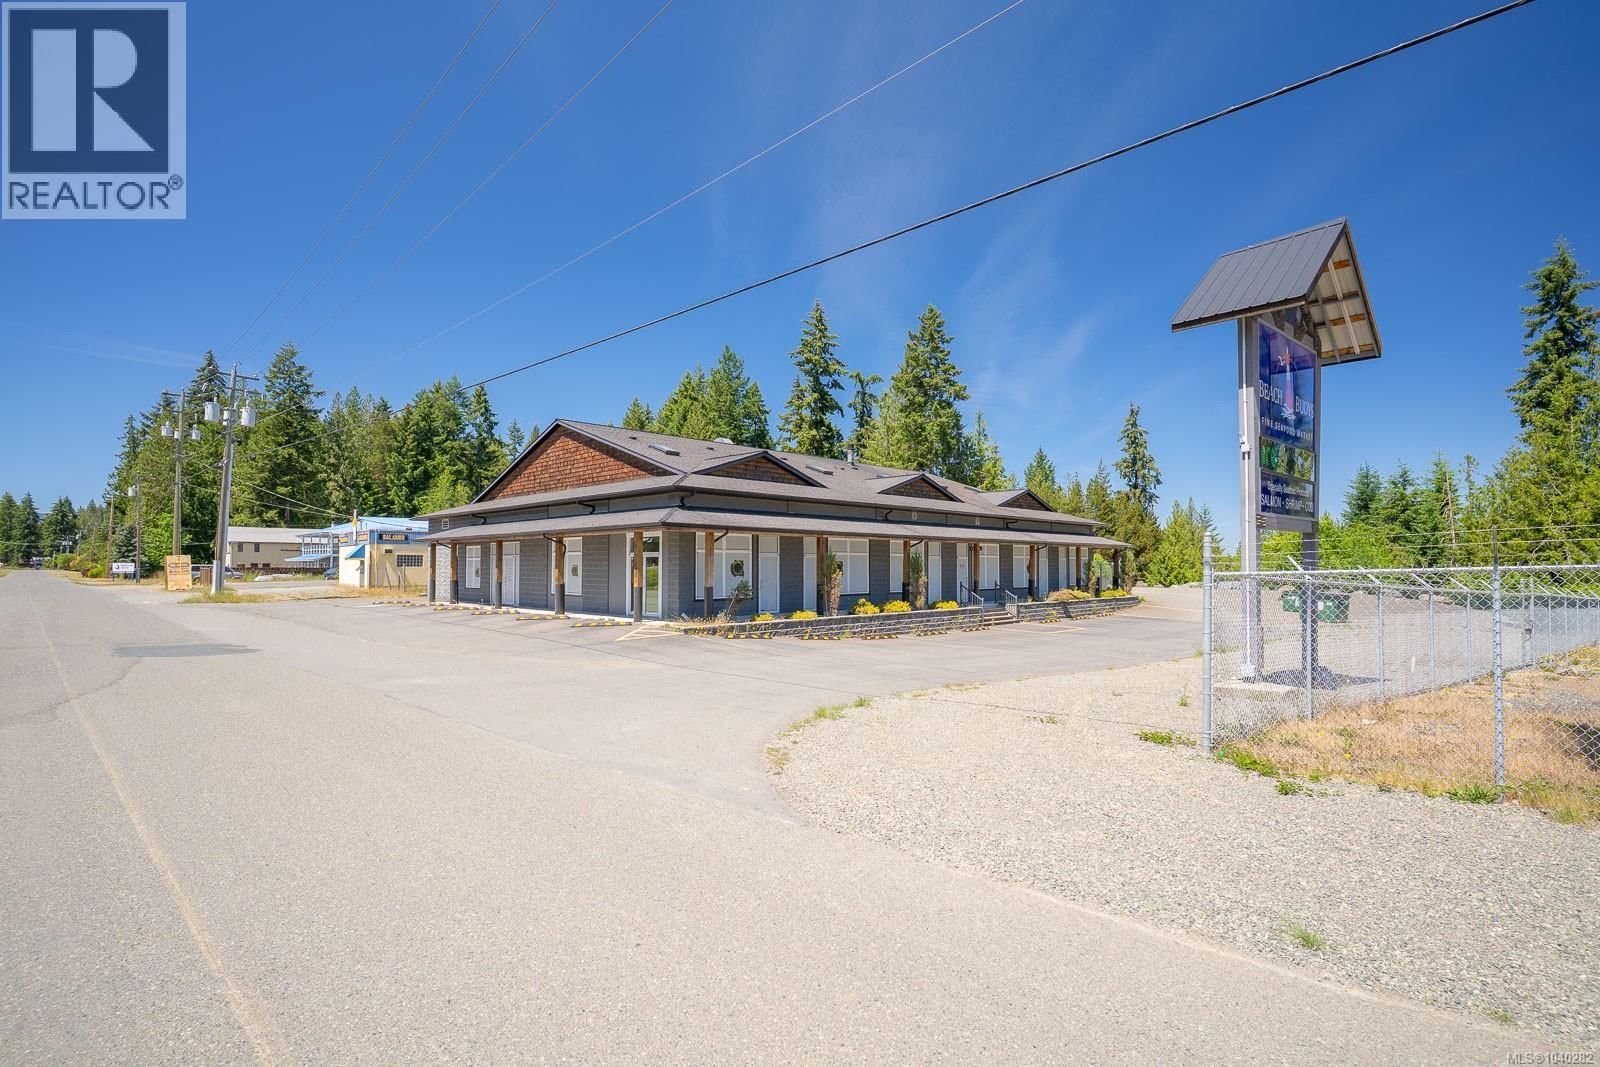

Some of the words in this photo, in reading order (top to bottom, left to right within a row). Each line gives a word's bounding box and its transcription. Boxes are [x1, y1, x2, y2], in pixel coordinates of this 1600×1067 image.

[1259, 379, 1283, 406] BEACH
[1261, 416, 1274, 428] FINE
[1274, 421, 1296, 436] SEAFOOD
[1260, 493, 1282, 508] SALMON
[1285, 497, 1303, 510] SHRIMP
[1304, 501, 1314, 512] COD
